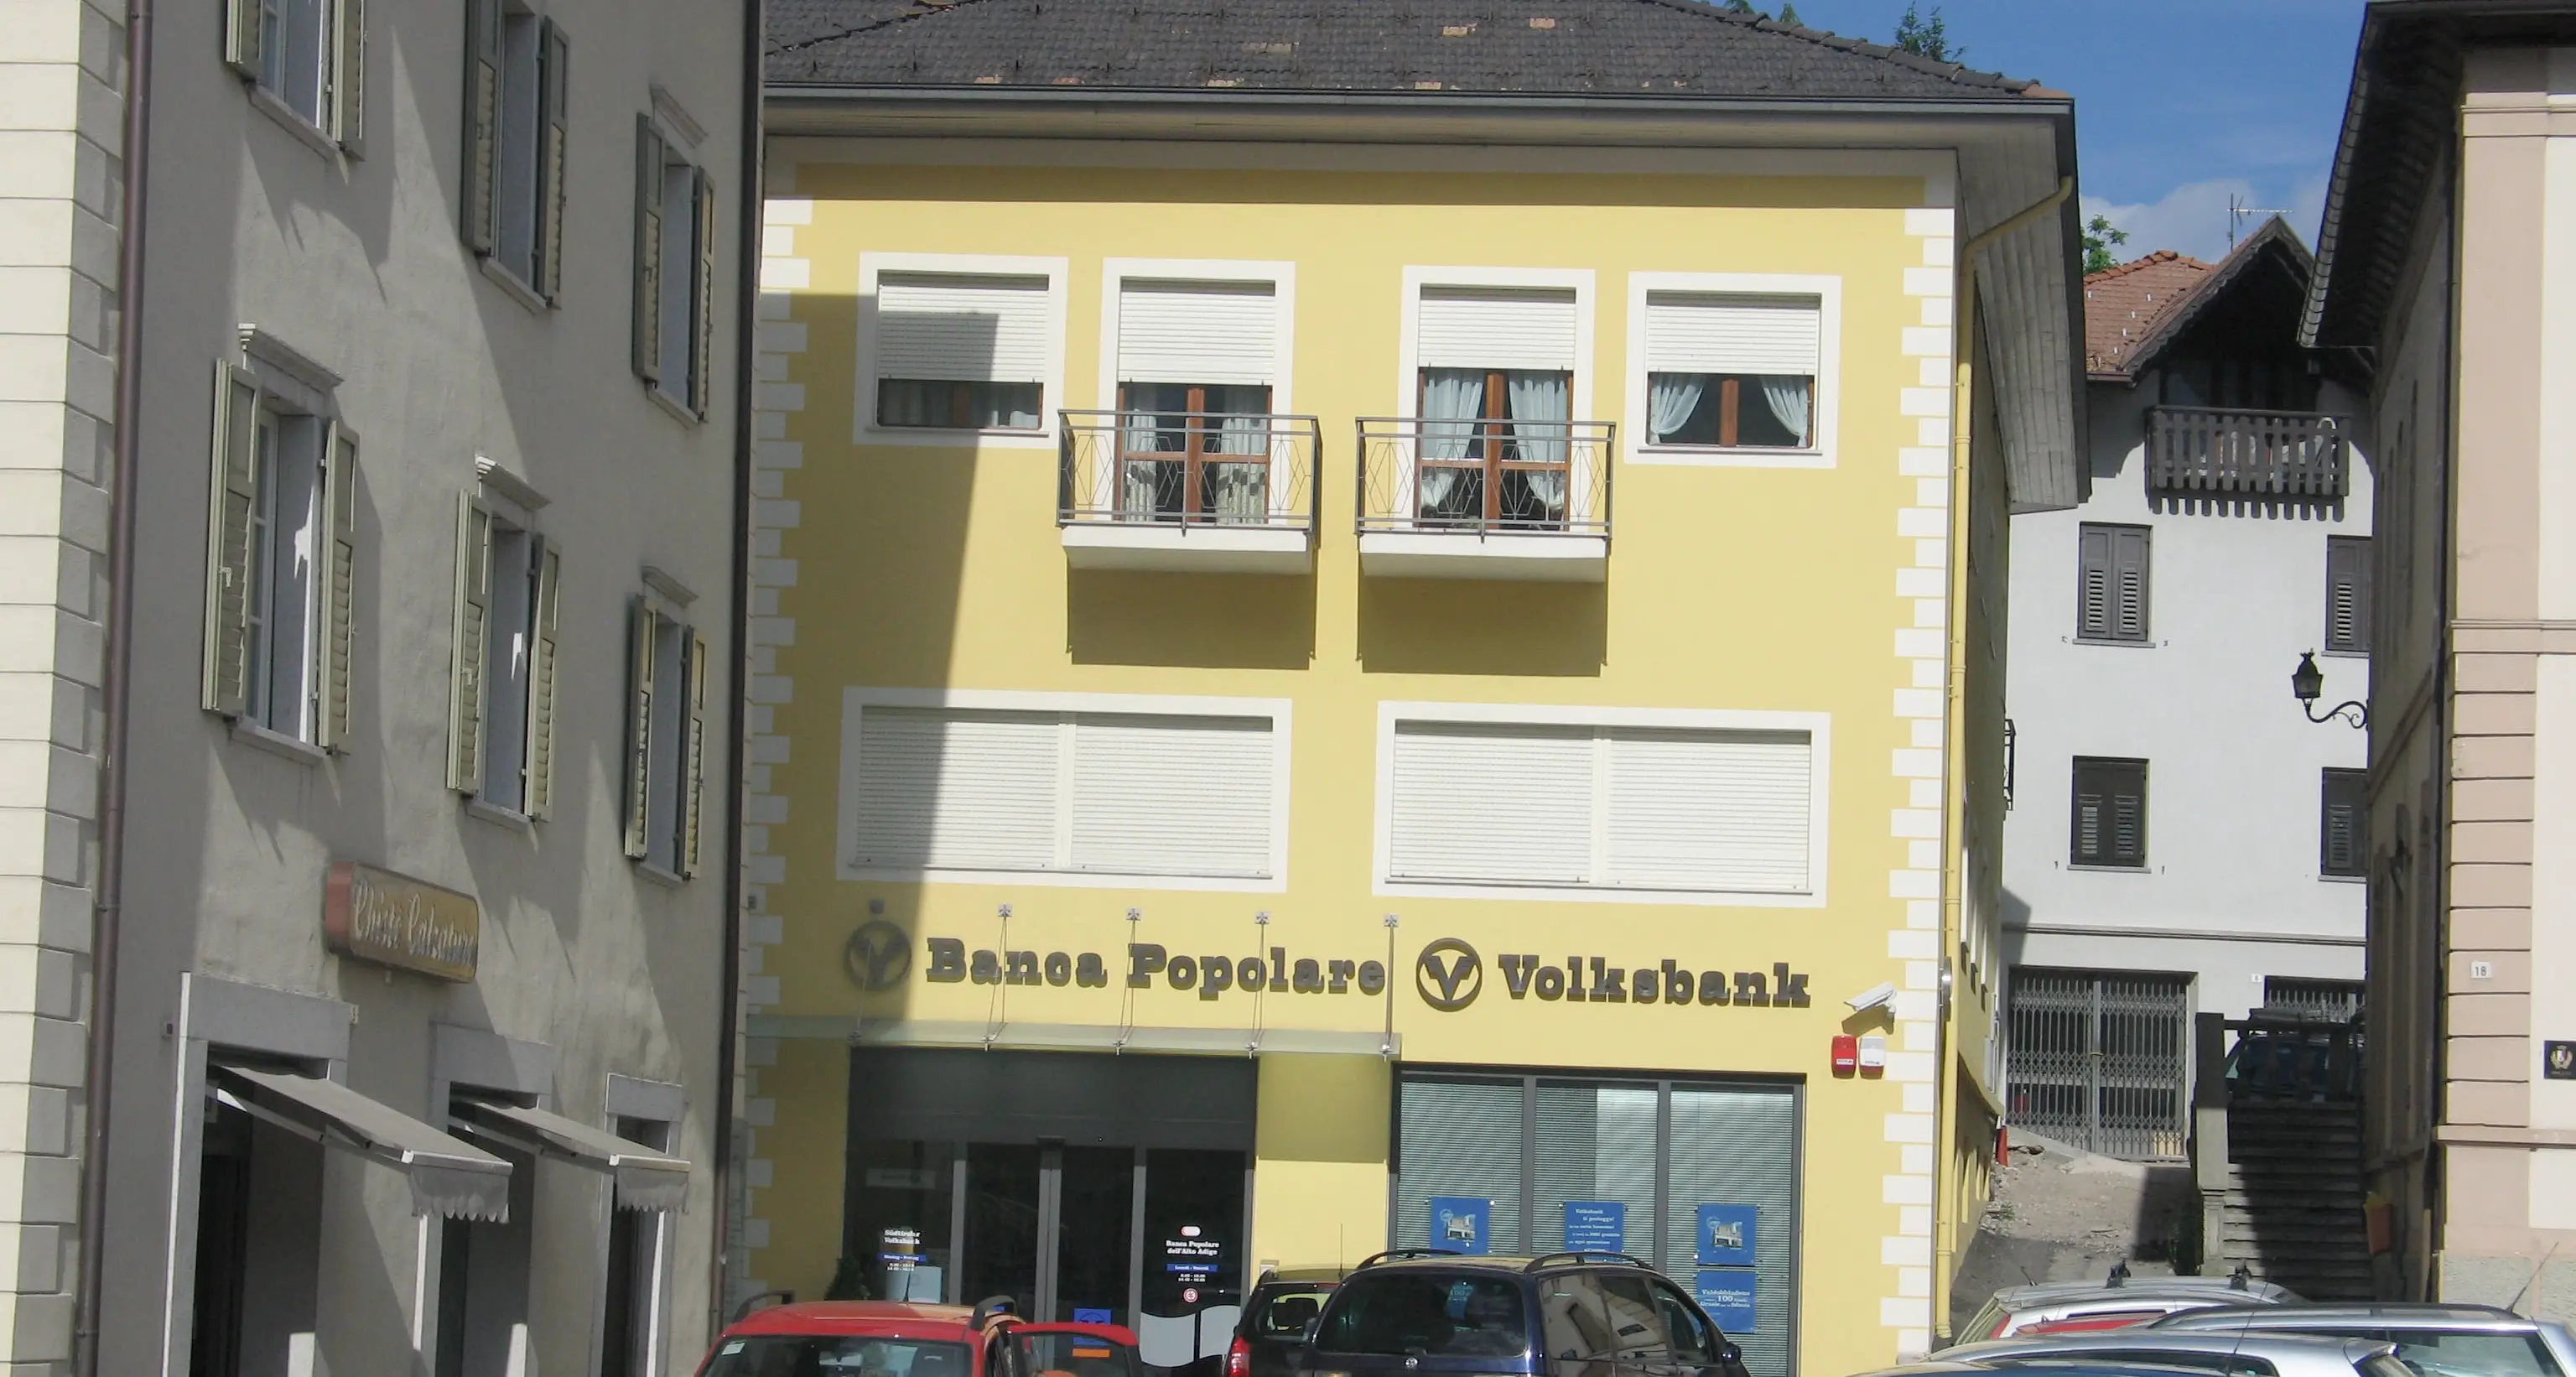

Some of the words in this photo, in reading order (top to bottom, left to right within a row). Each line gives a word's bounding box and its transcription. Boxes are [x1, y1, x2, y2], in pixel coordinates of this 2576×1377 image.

[926, 937, 1108, 988] Banca
[1128, 943, 1385, 1000] Popolare
[1498, 954, 1811, 1008] Volksbank
[2475, 966, 2487, 976] 18
